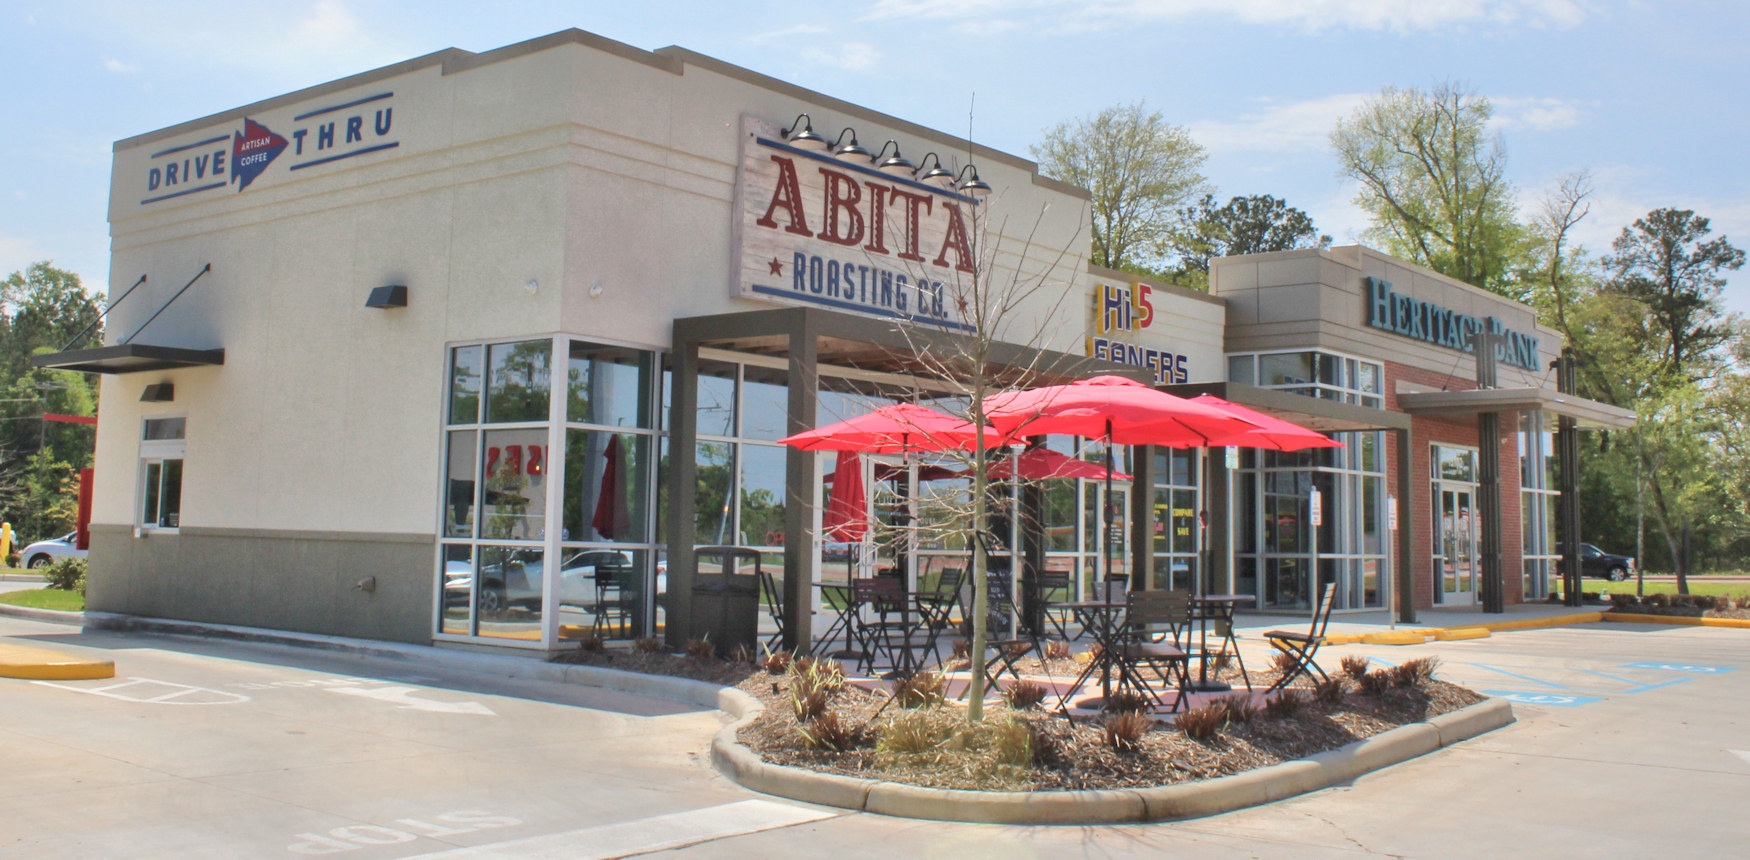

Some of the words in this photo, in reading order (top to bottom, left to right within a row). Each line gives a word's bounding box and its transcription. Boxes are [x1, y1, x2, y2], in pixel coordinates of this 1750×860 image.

[241, 136, 271, 152] ARTISAN
[293, 108, 393, 155] THRU
[148, 150, 226, 191] DRIVE
[241, 152, 267, 166] COFFEE
[757, 155, 974, 274] ABITA
[793, 252, 907, 311] ROASTING
[918, 278, 948, 318] CO.
[1098, 284, 1132, 334] Hi
[1134, 283, 1154, 330] 5
[1172, 508, 1193, 517] COMPARE
[1177, 527, 1189, 536] SAVE
[765, 531, 785, 546] OP
[287, 810, 523, 854] STOP
